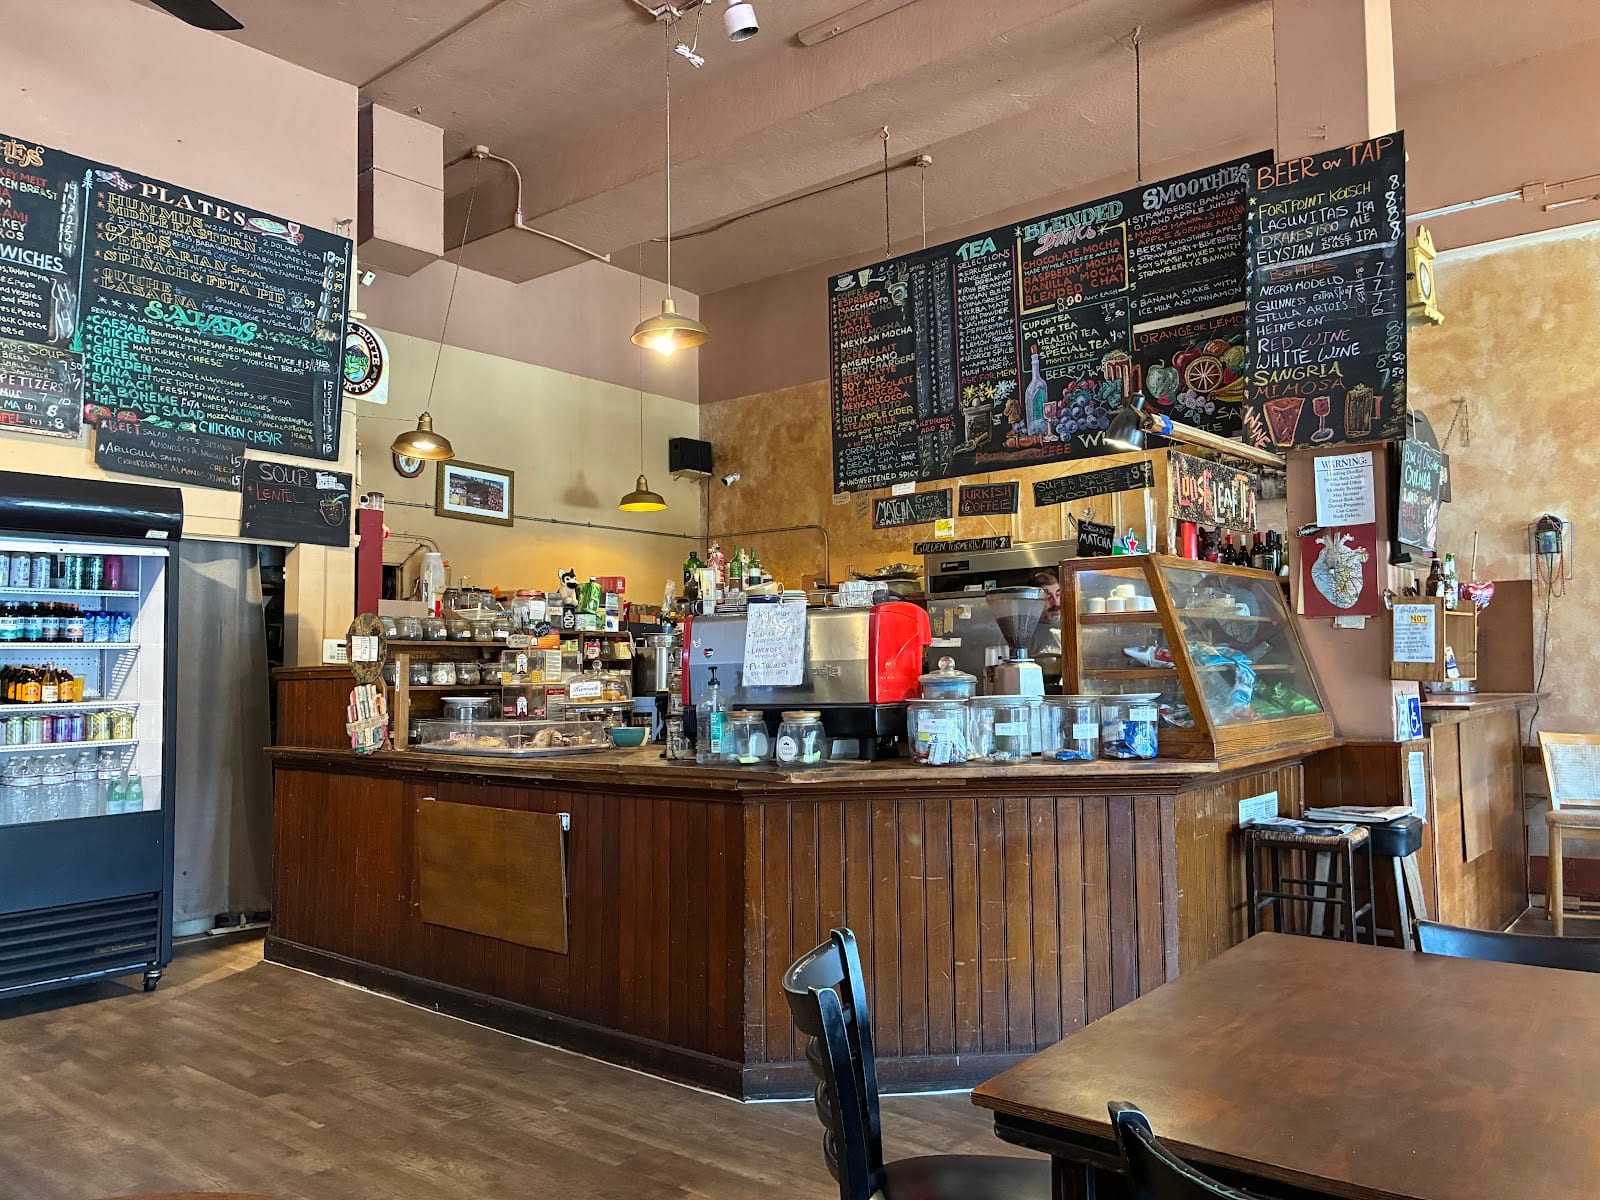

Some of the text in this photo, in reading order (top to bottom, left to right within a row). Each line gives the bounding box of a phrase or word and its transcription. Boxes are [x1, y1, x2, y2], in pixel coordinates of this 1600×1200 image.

[1257, 137, 1393, 190] BEER ON TAP
[20, 182, 58, 200] BREAST
[1330, 174, 1400, 203] KOLSCH 8
[107, 192, 204, 230] HUMMUS
[139, 182, 246, 226] PLATES
[1151, 198, 1237, 227] AND APPLE JUICE
[1260, 190, 1397, 234] LAGUNITAS IPA 8
[106, 202, 256, 254] MIDDLE EASTERN
[1022, 200, 1124, 243] BLENDED
[1138, 215, 1240, 246] APPLE JUICE
[1260, 206, 1400, 248] DRAKES ALE 8
[105, 222, 171, 248] GYROS
[1136, 223, 1242, 255] BERRY APPLE
[1256, 220, 1401, 266] ELYSIAN SPACE IPA 8
[104, 232, 227, 272] VEGETARIAN
[955, 237, 997, 261] TEA
[1022, 238, 1121, 270] CHOCOLATE MOCHA
[1137, 241, 1241, 271] SOY SPLASH MIXED WITH
[1138, 232, 1243, 262] STRAWBERRY BLUEBERRY
[957, 248, 1011, 271] SELECTIONS
[1023, 253, 1124, 285] RASPBERRY MOCHA
[1138, 251, 1237, 281] STRAWBERRY BANANA
[102, 267, 172, 294] QUICHE
[103, 249, 286, 305] SPINACH & FETA PIE
[1024, 263, 1124, 295] VANILLA MOCHA
[1130, 282, 1137, 291] 5
[1260, 276, 1344, 297] NEGRA MODELO
[101, 276, 198, 311] LASAGNA
[838, 290, 880, 308] ESPRESSO
[1025, 271, 1124, 307] BLENDED CHAI
[1130, 279, 1237, 310] 6 BANANA SHAKE WITH
[838, 296, 889, 315] MACCHIATTO
[1138, 286, 1242, 316] ICE AND CINNAMON
[1254, 301, 1349, 324] STELLA ARTOIS
[1255, 297, 1306, 313] GUINNESS
[93, 315, 147, 337] CAESAR
[144, 299, 258, 341] SALADS
[840, 315, 871, 328] LATTE
[840, 322, 872, 336] MOCHA
[1057, 321, 1079, 332] TEA
[1257, 315, 1325, 337] HEINEKEN
[93, 325, 150, 346] CHICKEN
[94, 334, 130, 351] CHEF
[356, 325, 382, 367] BUTTE
[840, 326, 913, 350] MEXICAN MOCHA
[965, 327, 1014, 343] CHAMOMILLE
[965, 339, 990, 350] LEMON
[1037, 327, 1100, 347] HEALTHY TEA
[1140, 325, 1193, 344] ORANGE
[1258, 328, 1351, 354] RED WINE
[93, 344, 139, 363] GREEK
[841, 351, 898, 369] AMERICANO
[992, 346, 1015, 357] SPICE
[1039, 337, 1111, 360] SPECIAL TEA
[1074, 351, 1096, 361] LEAF
[1256, 341, 1361, 371] WHITE WINE
[91, 361, 132, 379] TUNA
[93, 353, 152, 375] GARDEN
[1254, 360, 1344, 387] SANGRIA
[91, 371, 189, 397] SPINACH FRESH
[93, 382, 178, 407] LA BOHEME
[842, 376, 887, 391] SOY MILK
[862, 375, 914, 396] CHOCOLATE
[1253, 377, 1346, 400] MIMOSA
[92, 391, 206, 422] THE LAST SALAD
[842, 391, 911, 413] MEXICAN COCOA
[842, 405, 914, 425] HOT APPLE CIDER
[108, 419, 141, 436] BEET
[199, 420, 284, 447] CHICKEN CAESAR
[843, 421, 873, 433] STEAM
[105, 442, 157, 461] ARUGULA
[874, 448, 895, 459] CHAI
[878, 439, 899, 450] CHAI
[846, 469, 919, 487] UNSWEETENED SPICY
[1036, 479, 1078, 494] SUPER
[961, 486, 1012, 500] TURKISH
[876, 498, 918, 522] MATCHA
[1079, 532, 1113, 551] MATCHA
[1410, 615, 1428, 624] NOT
